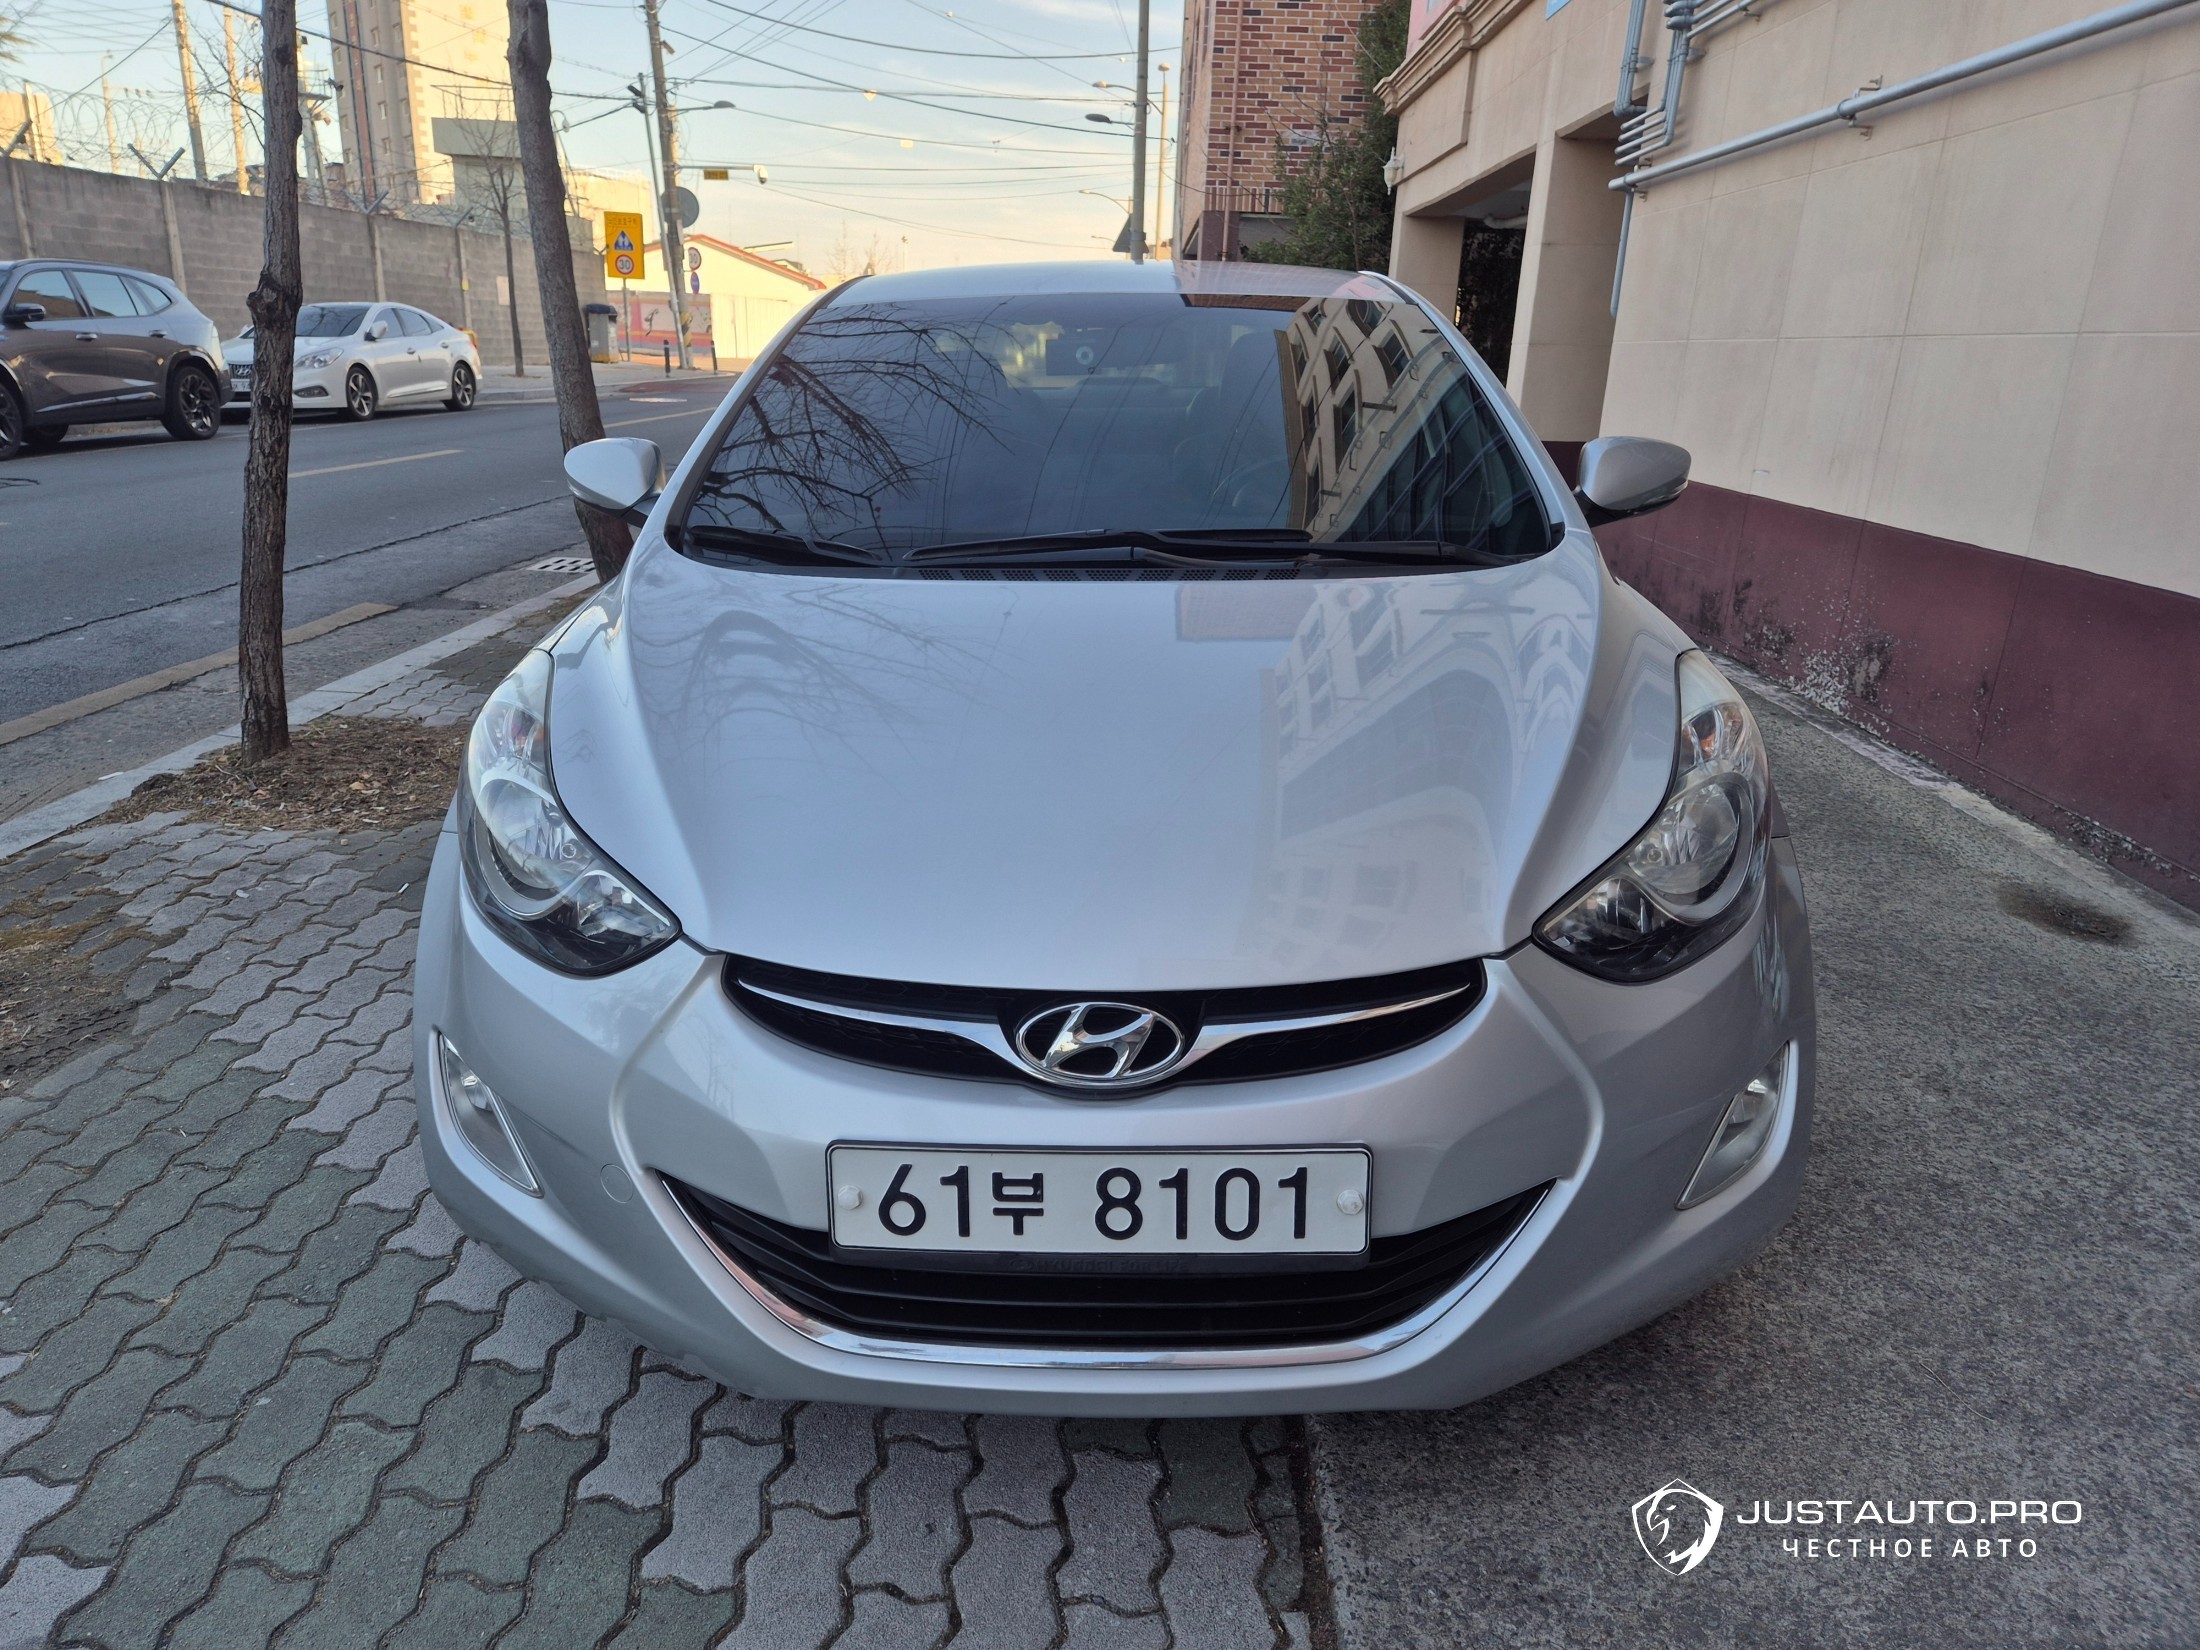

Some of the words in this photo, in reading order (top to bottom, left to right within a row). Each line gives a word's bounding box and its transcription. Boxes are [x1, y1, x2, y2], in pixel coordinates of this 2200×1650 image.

[619, 259, 631, 270] 30
[878, 1163, 1045, 1238] 61부
[1094, 1166, 1308, 1241] 8101
